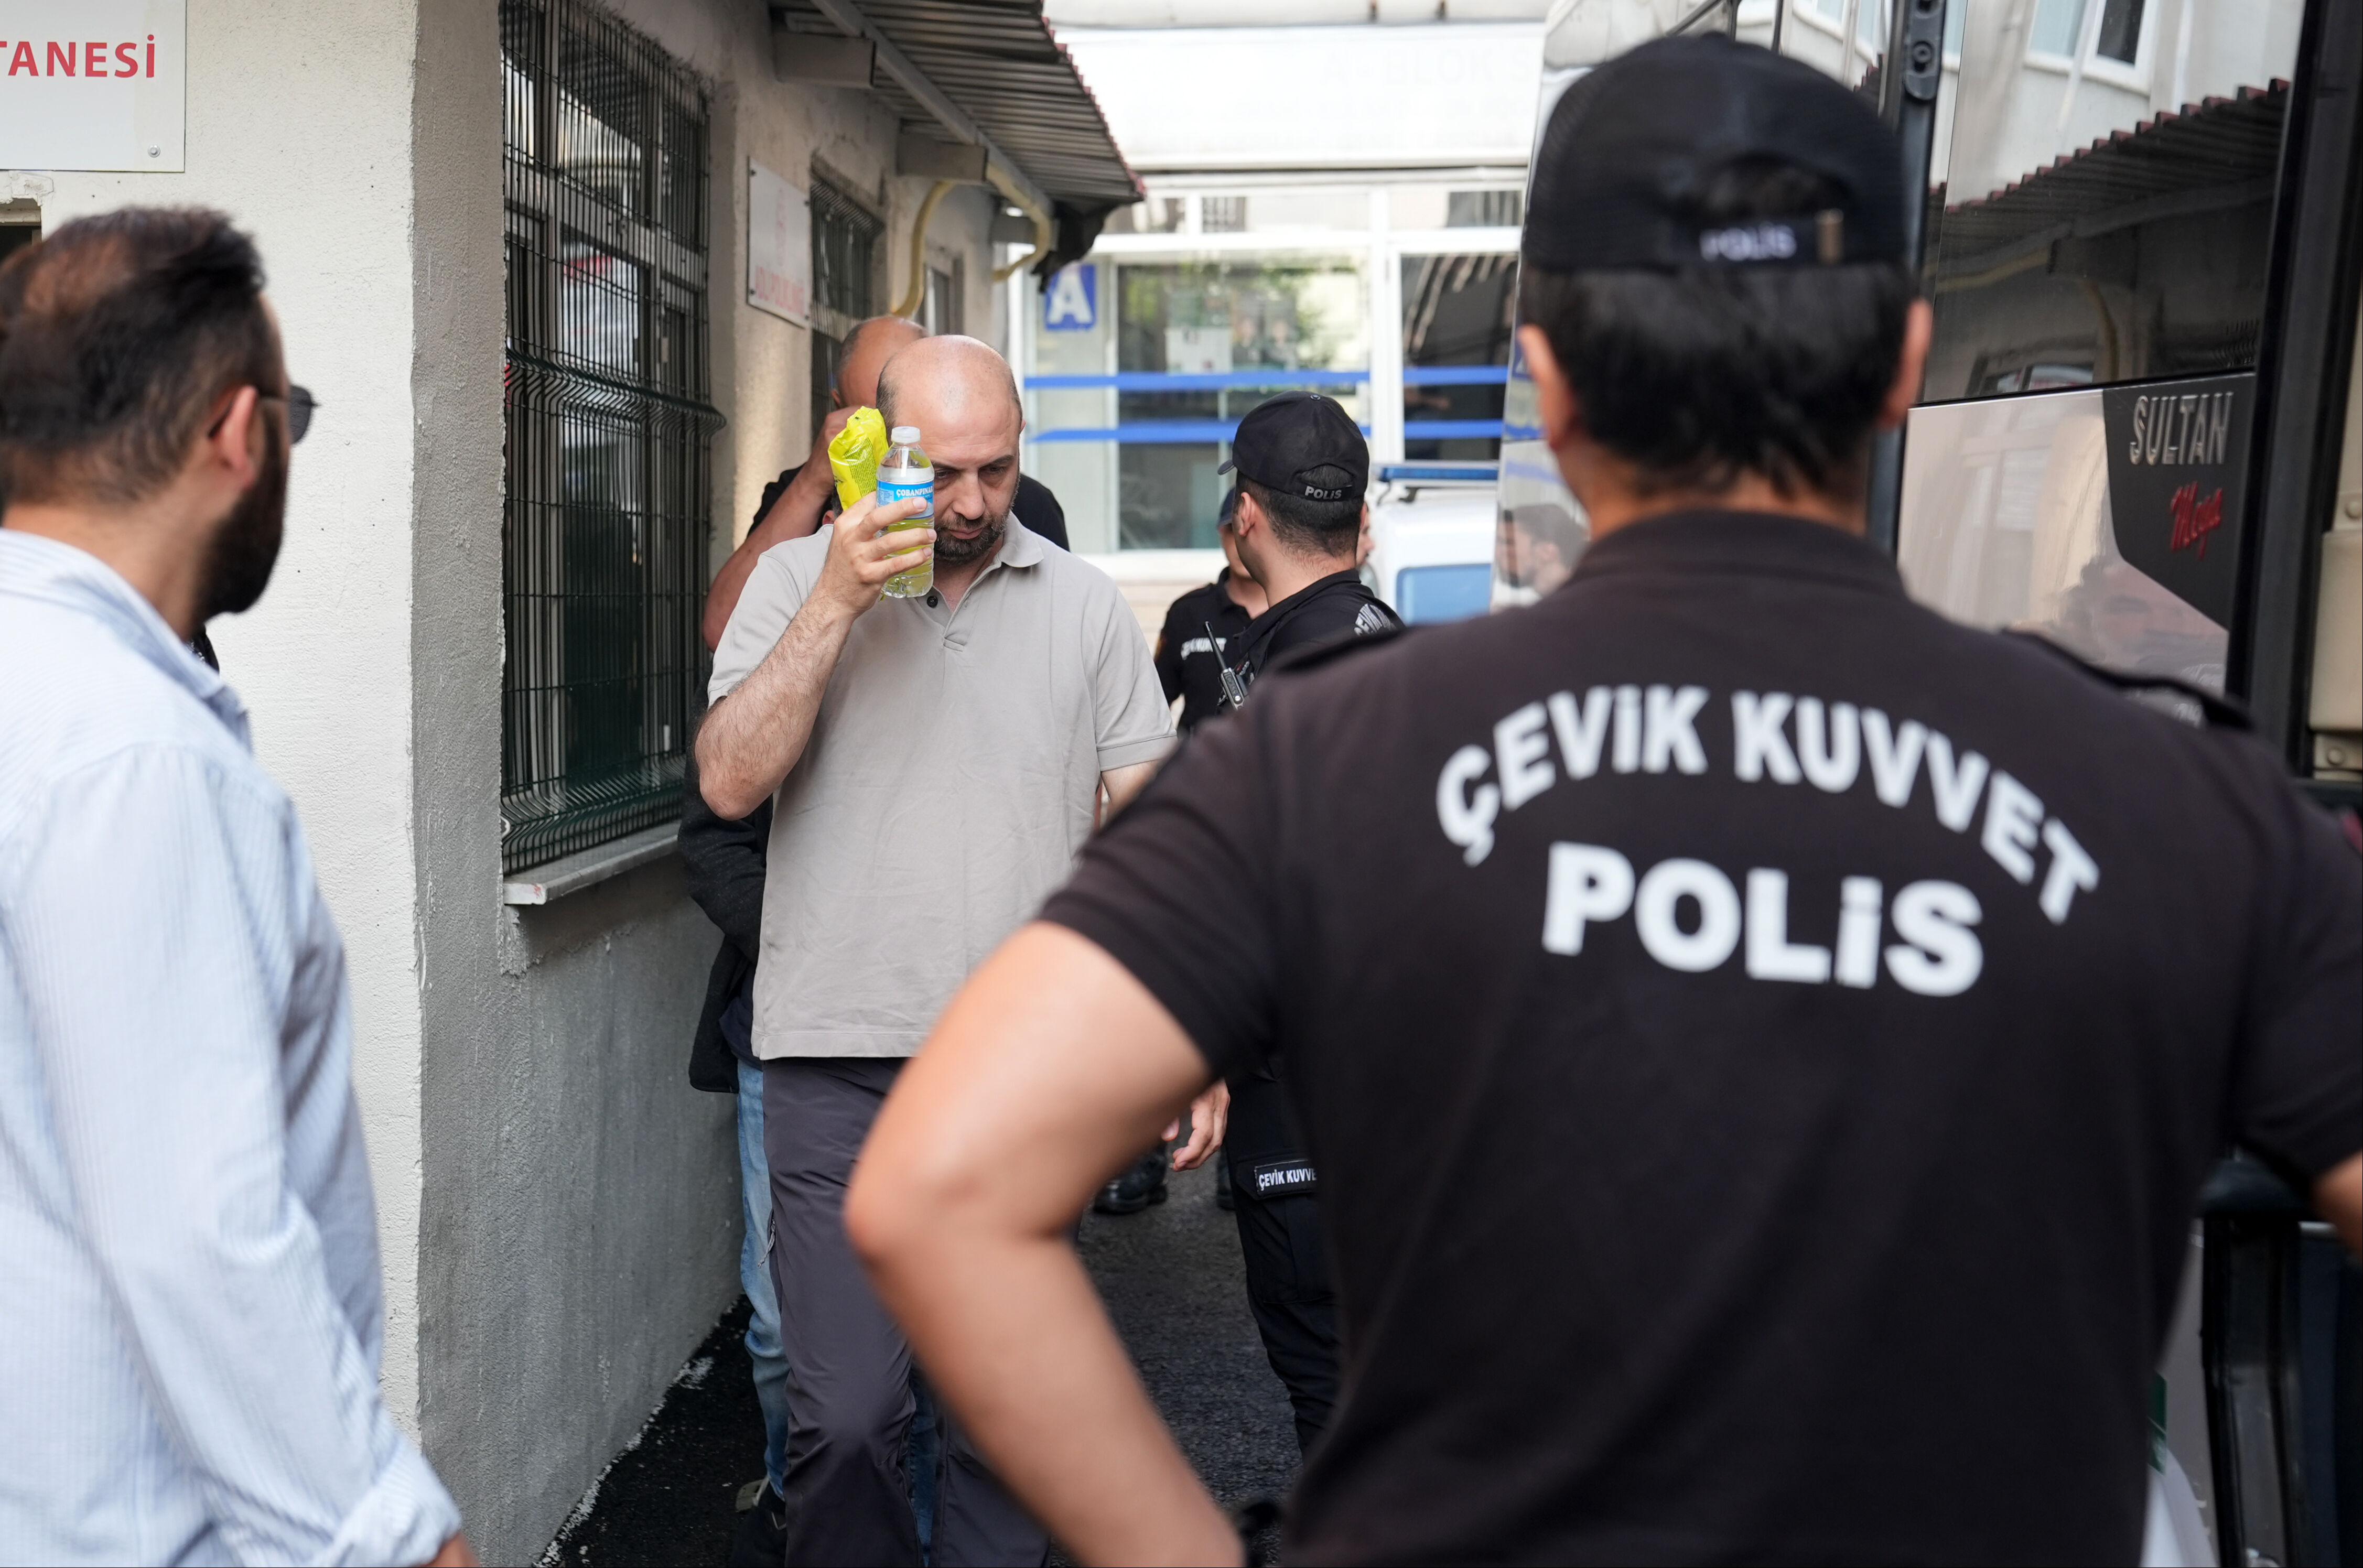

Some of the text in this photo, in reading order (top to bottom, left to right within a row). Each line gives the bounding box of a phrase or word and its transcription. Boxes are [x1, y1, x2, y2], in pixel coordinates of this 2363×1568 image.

[1049, 261, 1092, 324] A
[2130, 392, 2233, 465] SULTAN
[1731, 690, 2099, 925] KUVVET
[1259, 1169, 1285, 1191] ÇEVİK
